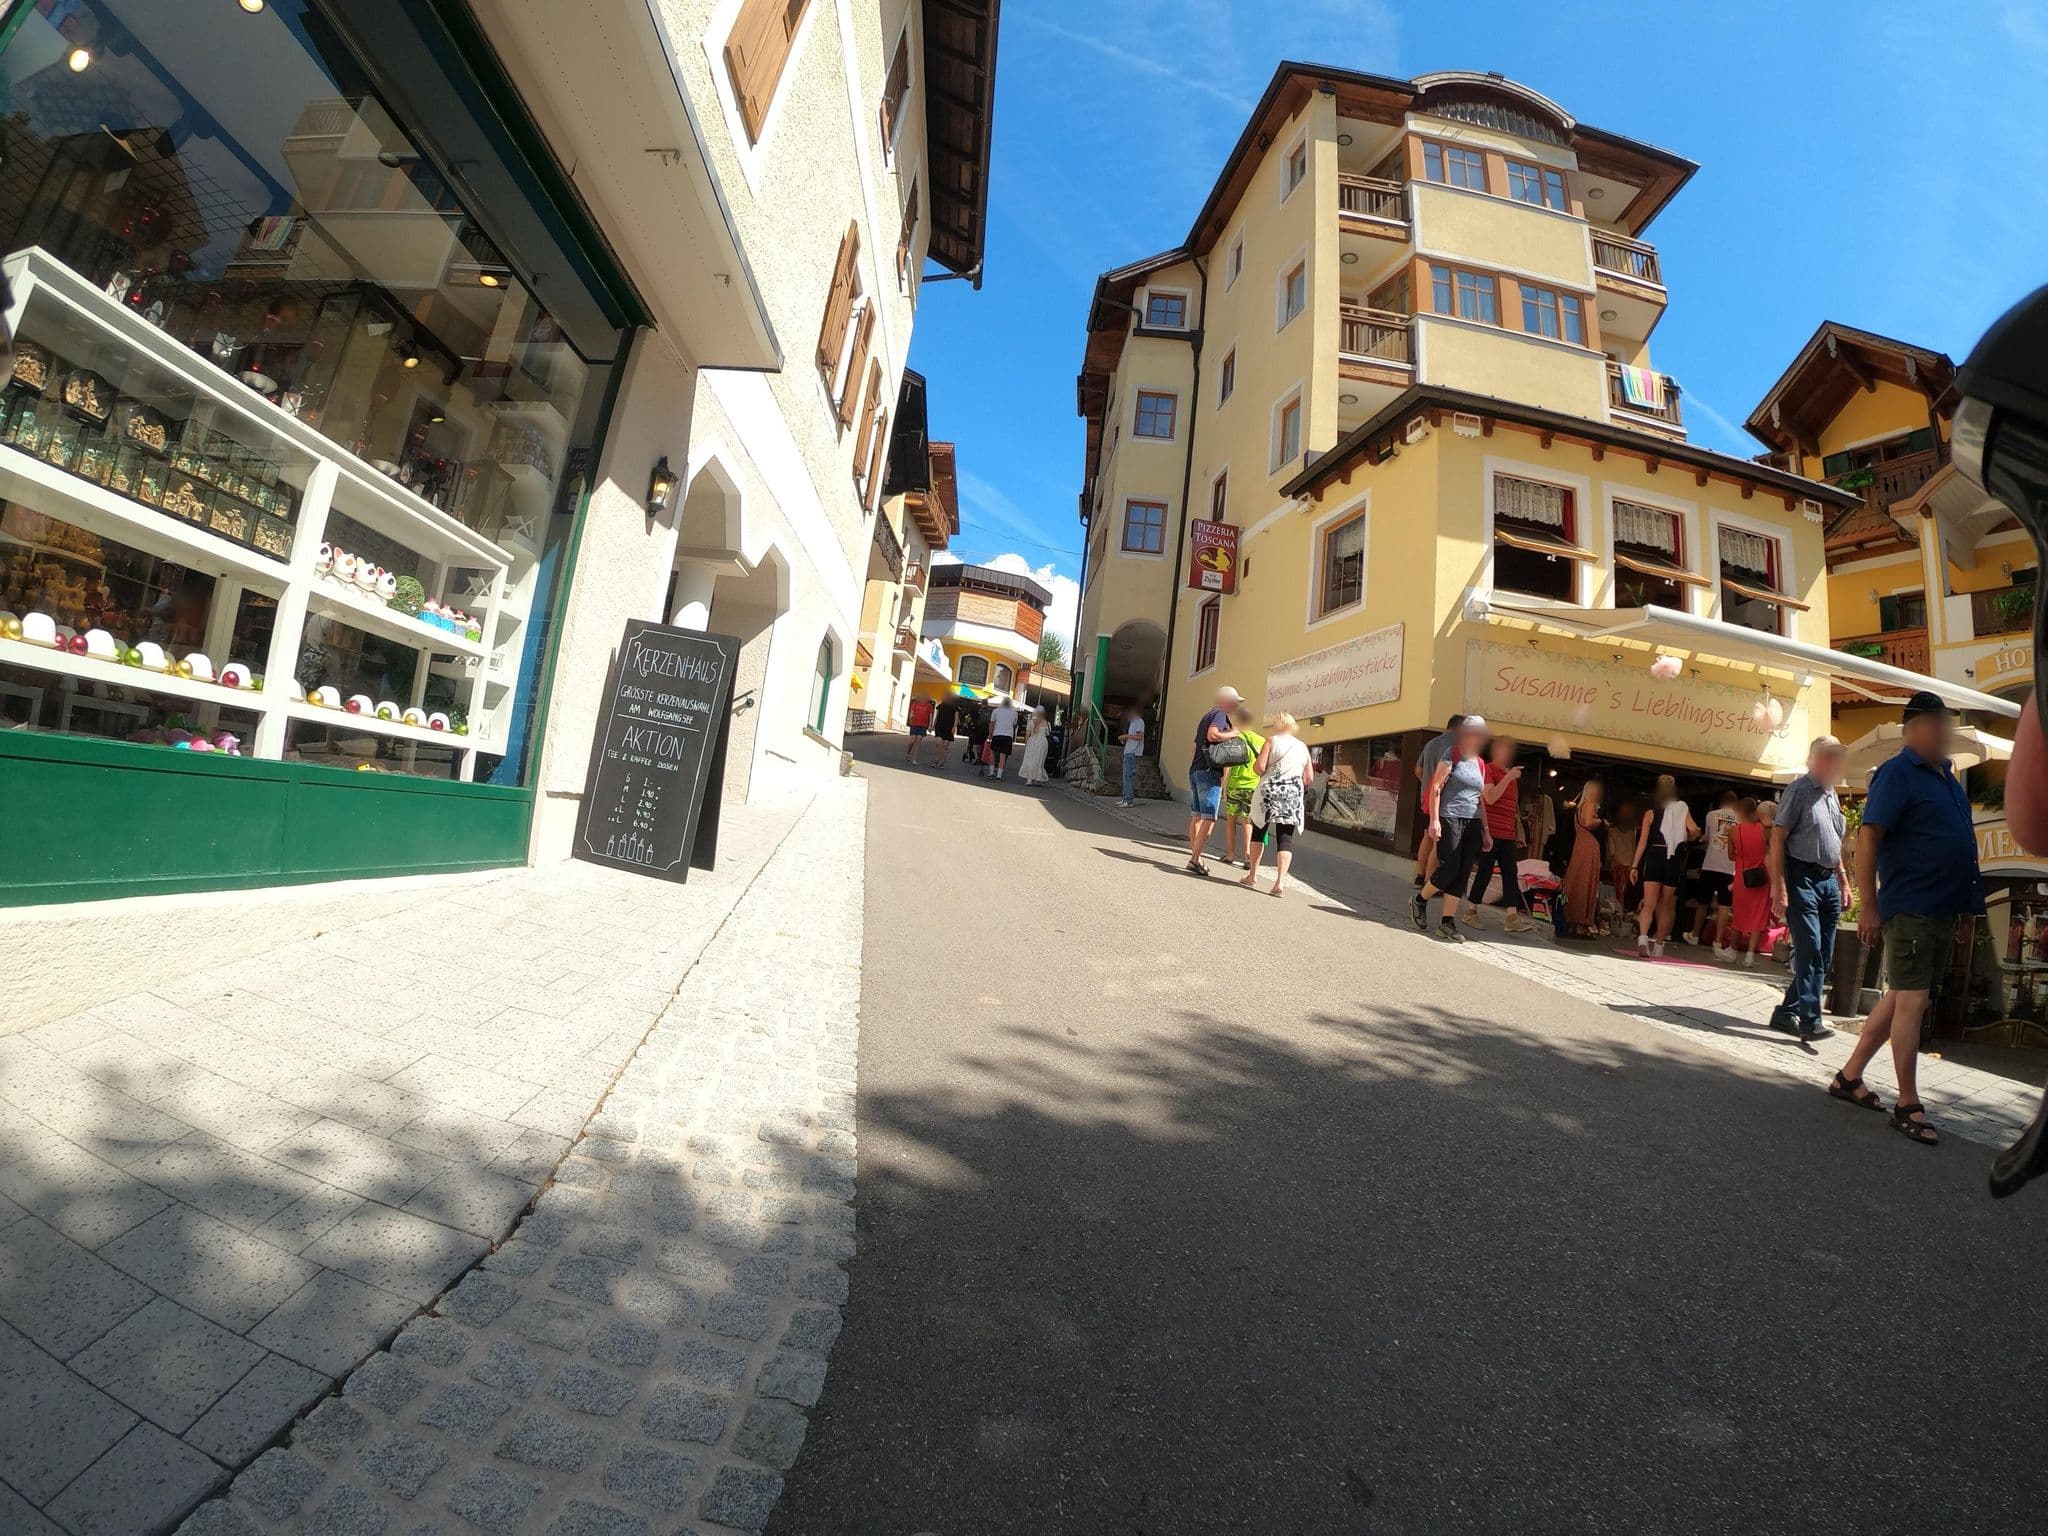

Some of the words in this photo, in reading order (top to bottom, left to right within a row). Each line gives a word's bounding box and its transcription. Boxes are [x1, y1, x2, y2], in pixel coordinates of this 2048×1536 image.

[1197, 522, 1235, 538] PIZZERIA
[1193, 533, 1236, 549] TOSCANA
[633, 641, 719, 684] KERZENHAUS
[620, 684, 655, 703] GRÖSSTE
[656, 692, 710, 714] KERZENAUSWAHL
[629, 703, 641, 715] AM
[648, 707, 695, 725] WOLFGANGSEE
[621, 725, 686, 761] AKTION
[608, 748, 620, 759] TEE
[630, 754, 652, 766] KAFFEE
[657, 761, 680, 772] DOSEN
[626, 773, 632, 783] S
[623, 785, 630, 793] M
[621, 795, 626, 803] L
